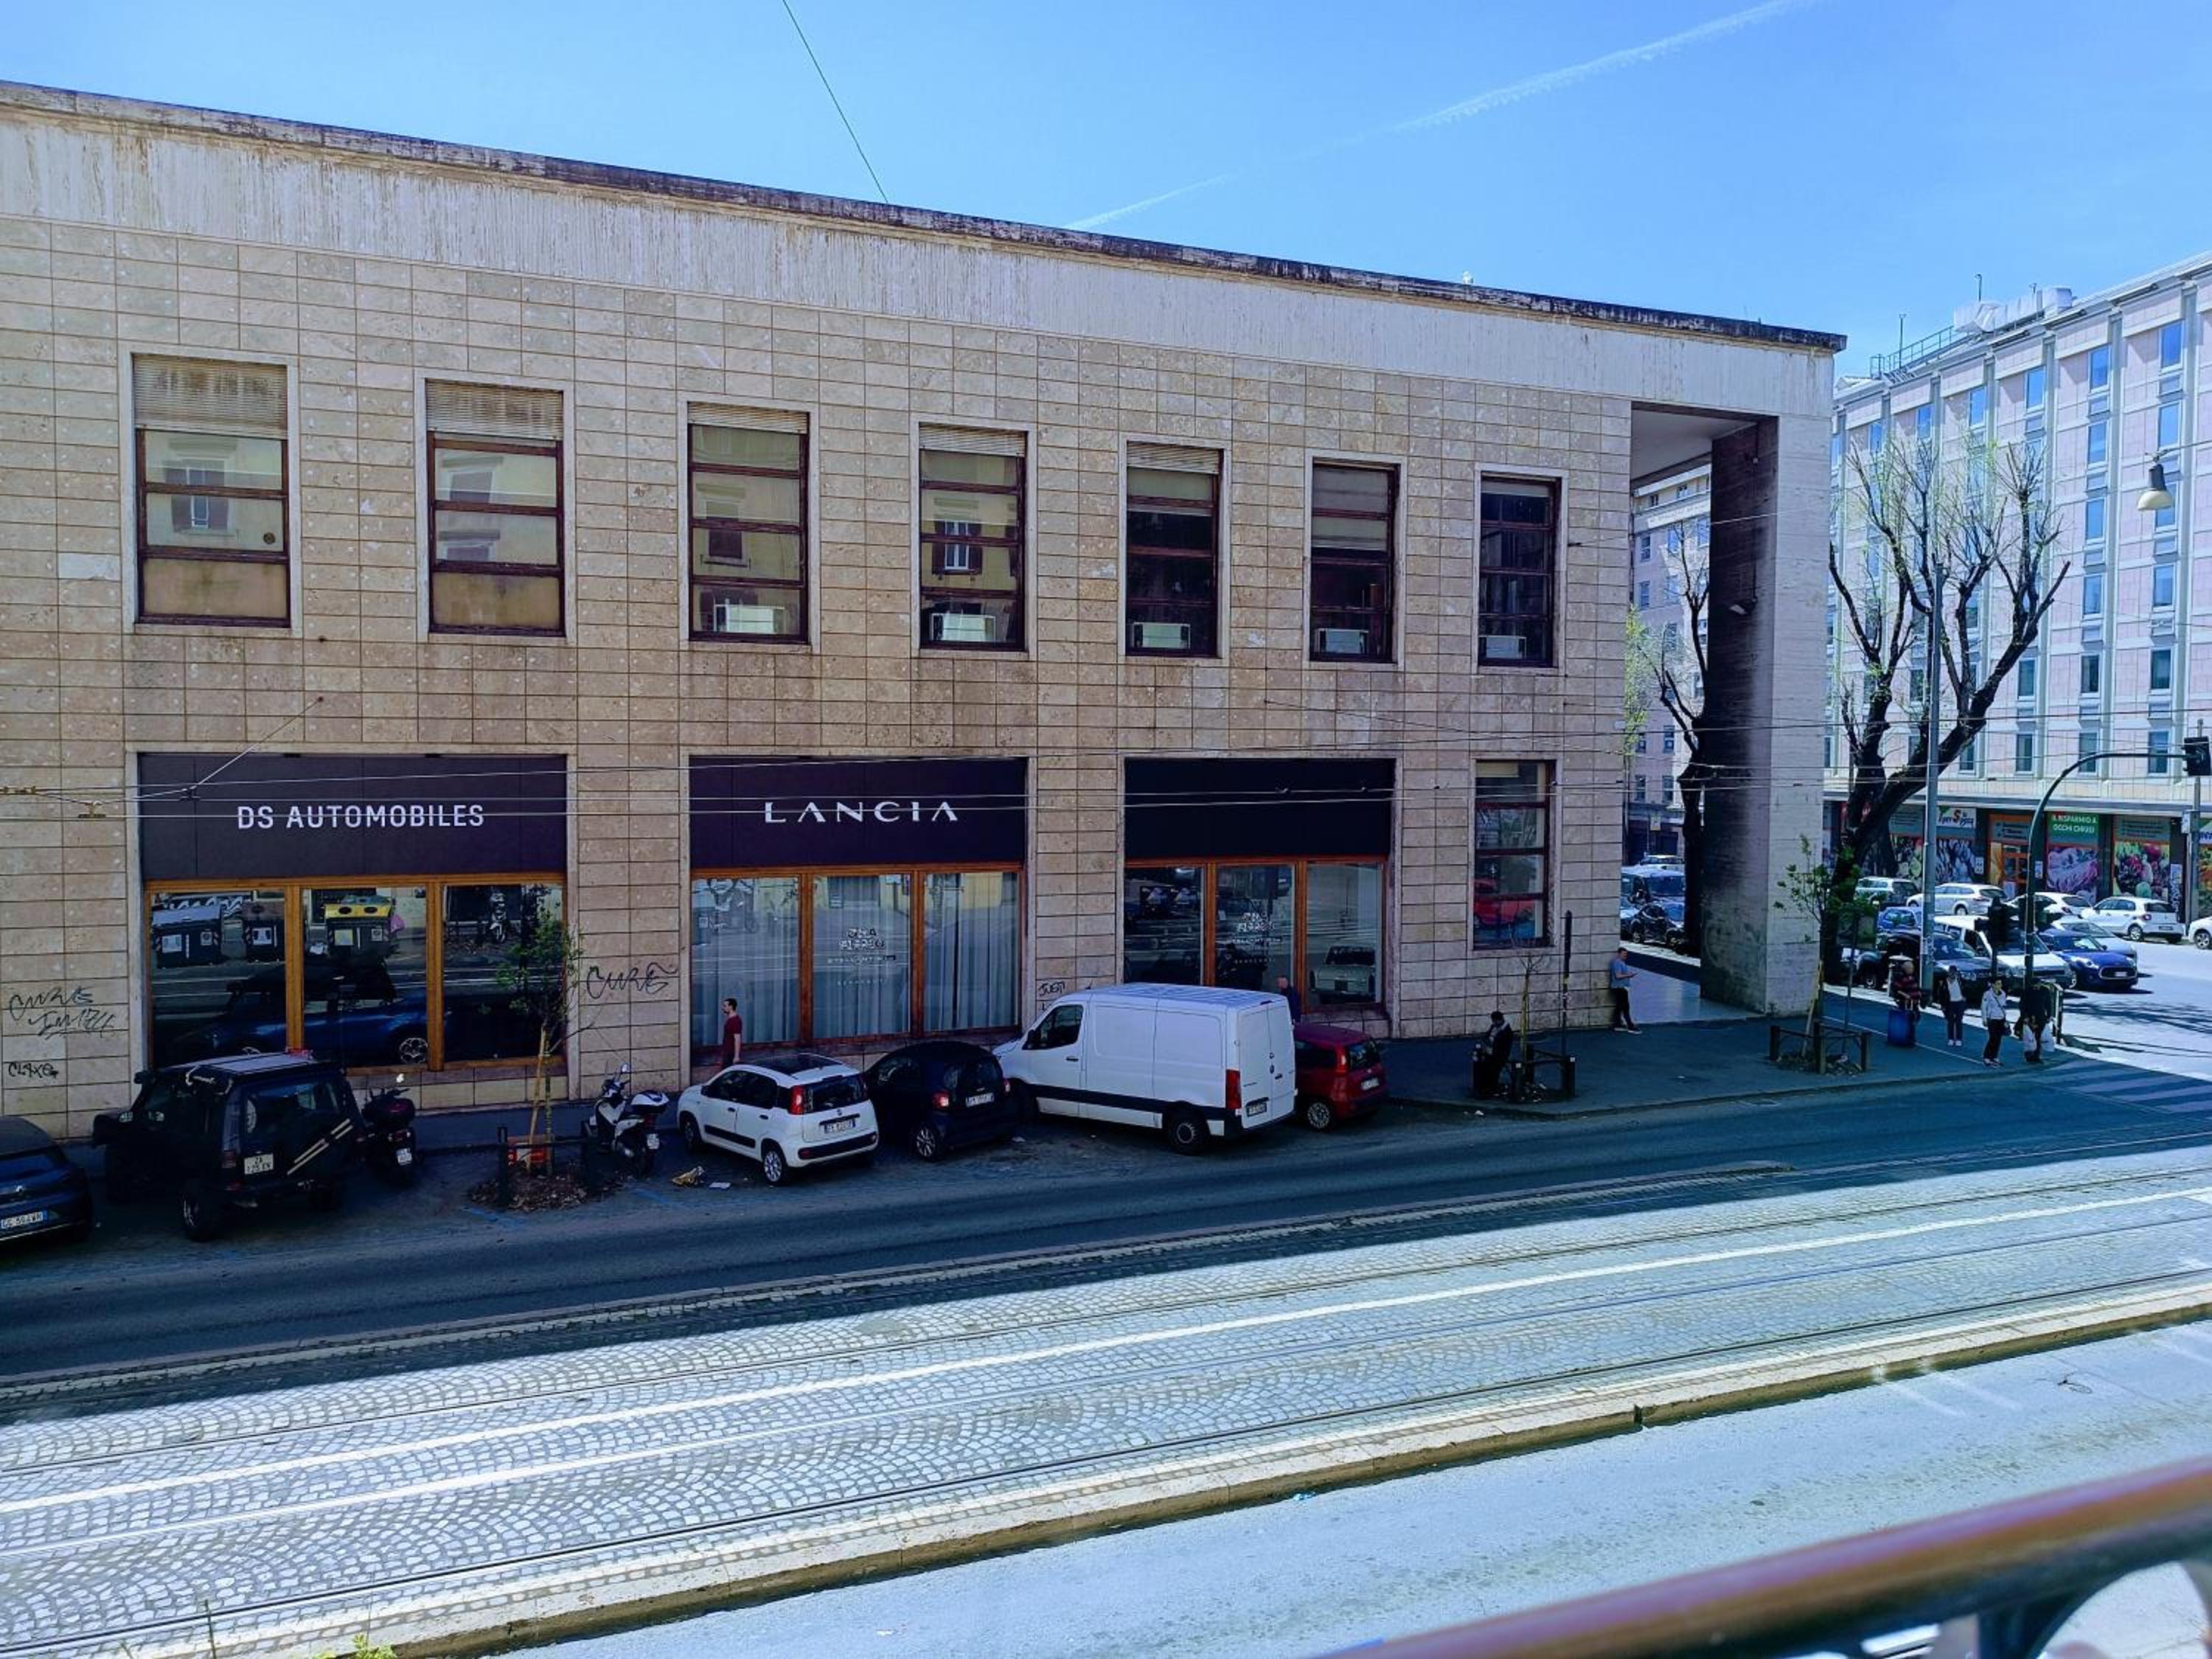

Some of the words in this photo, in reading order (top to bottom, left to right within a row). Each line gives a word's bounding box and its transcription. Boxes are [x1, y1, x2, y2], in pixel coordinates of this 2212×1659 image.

[237, 805, 274, 829] DS
[286, 804, 484, 828] AUTOMOBILES
[765, 801, 959, 823] LANCIA
